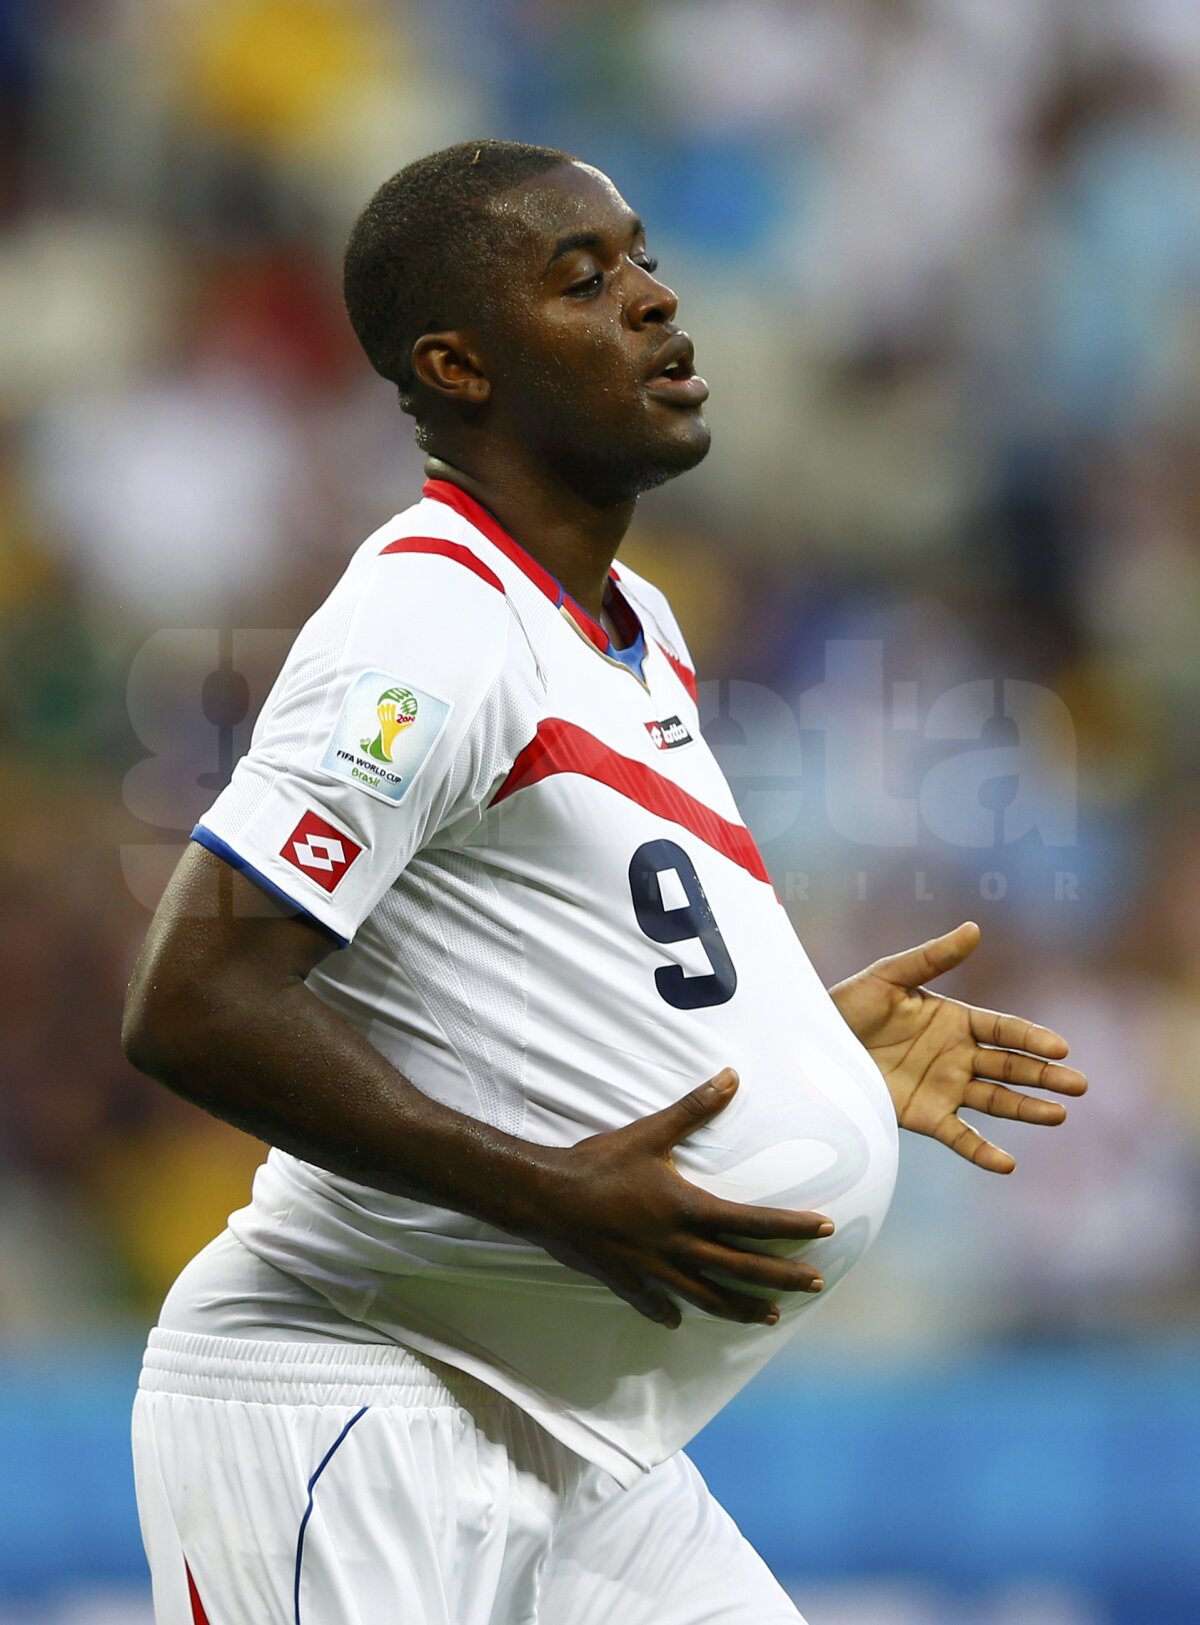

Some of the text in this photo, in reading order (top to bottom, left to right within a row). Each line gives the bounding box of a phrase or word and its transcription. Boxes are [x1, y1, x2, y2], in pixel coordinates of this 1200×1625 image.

[336, 750, 402, 784] FIFA WORLD CUP
[351, 767, 381, 788] Brasil
[628, 838, 738, 1010] 9
